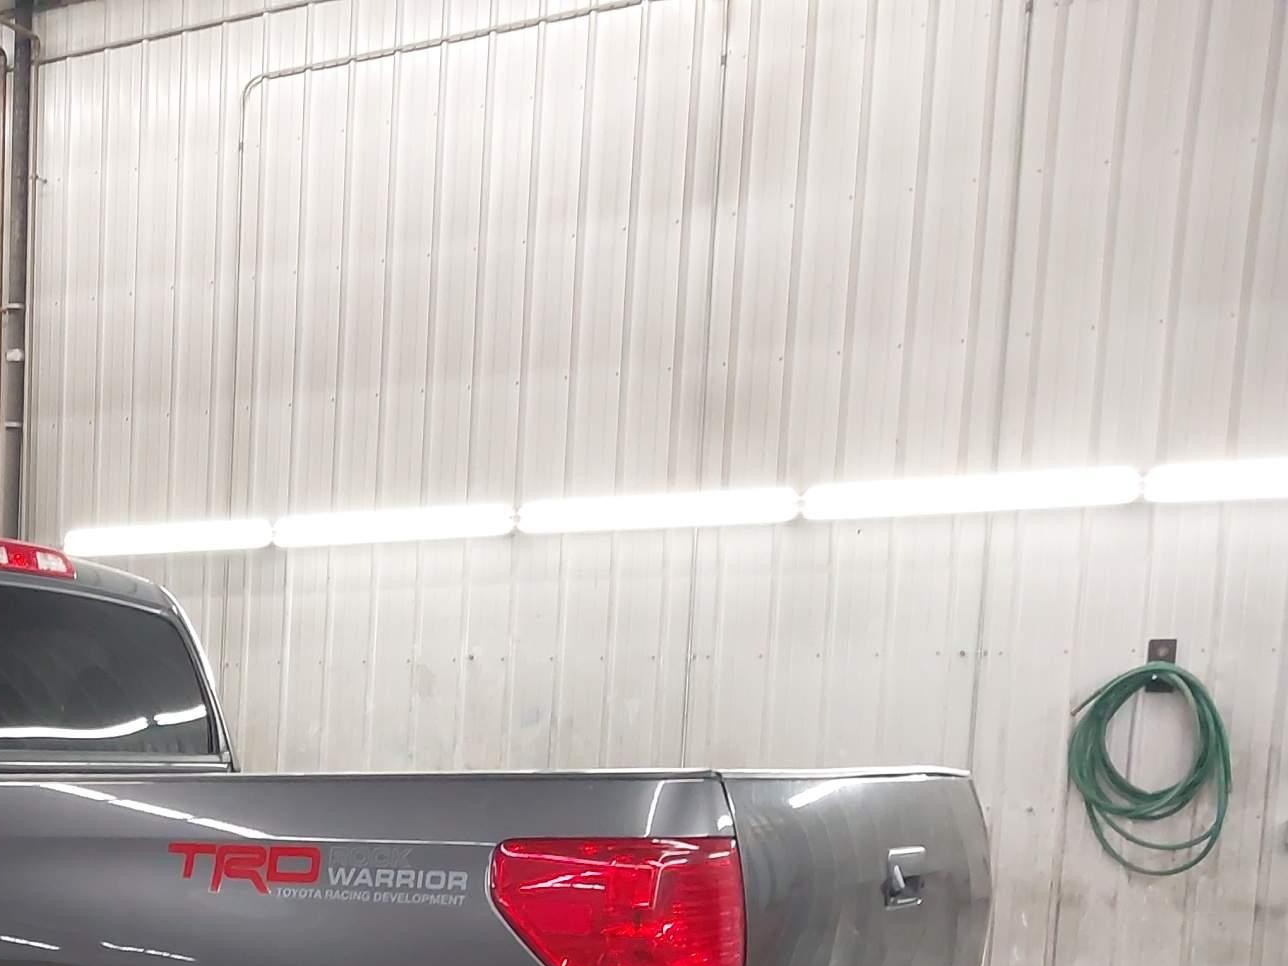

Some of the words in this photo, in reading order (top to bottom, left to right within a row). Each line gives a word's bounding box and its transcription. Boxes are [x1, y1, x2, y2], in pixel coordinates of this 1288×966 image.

[168, 841, 322, 894] TRD
[328, 867, 469, 891] WARRIOR
[276, 886, 322, 900] TOYOTA
[324, 889, 370, 903] RACING
[373, 891, 466, 906] DEVELOPMENT
